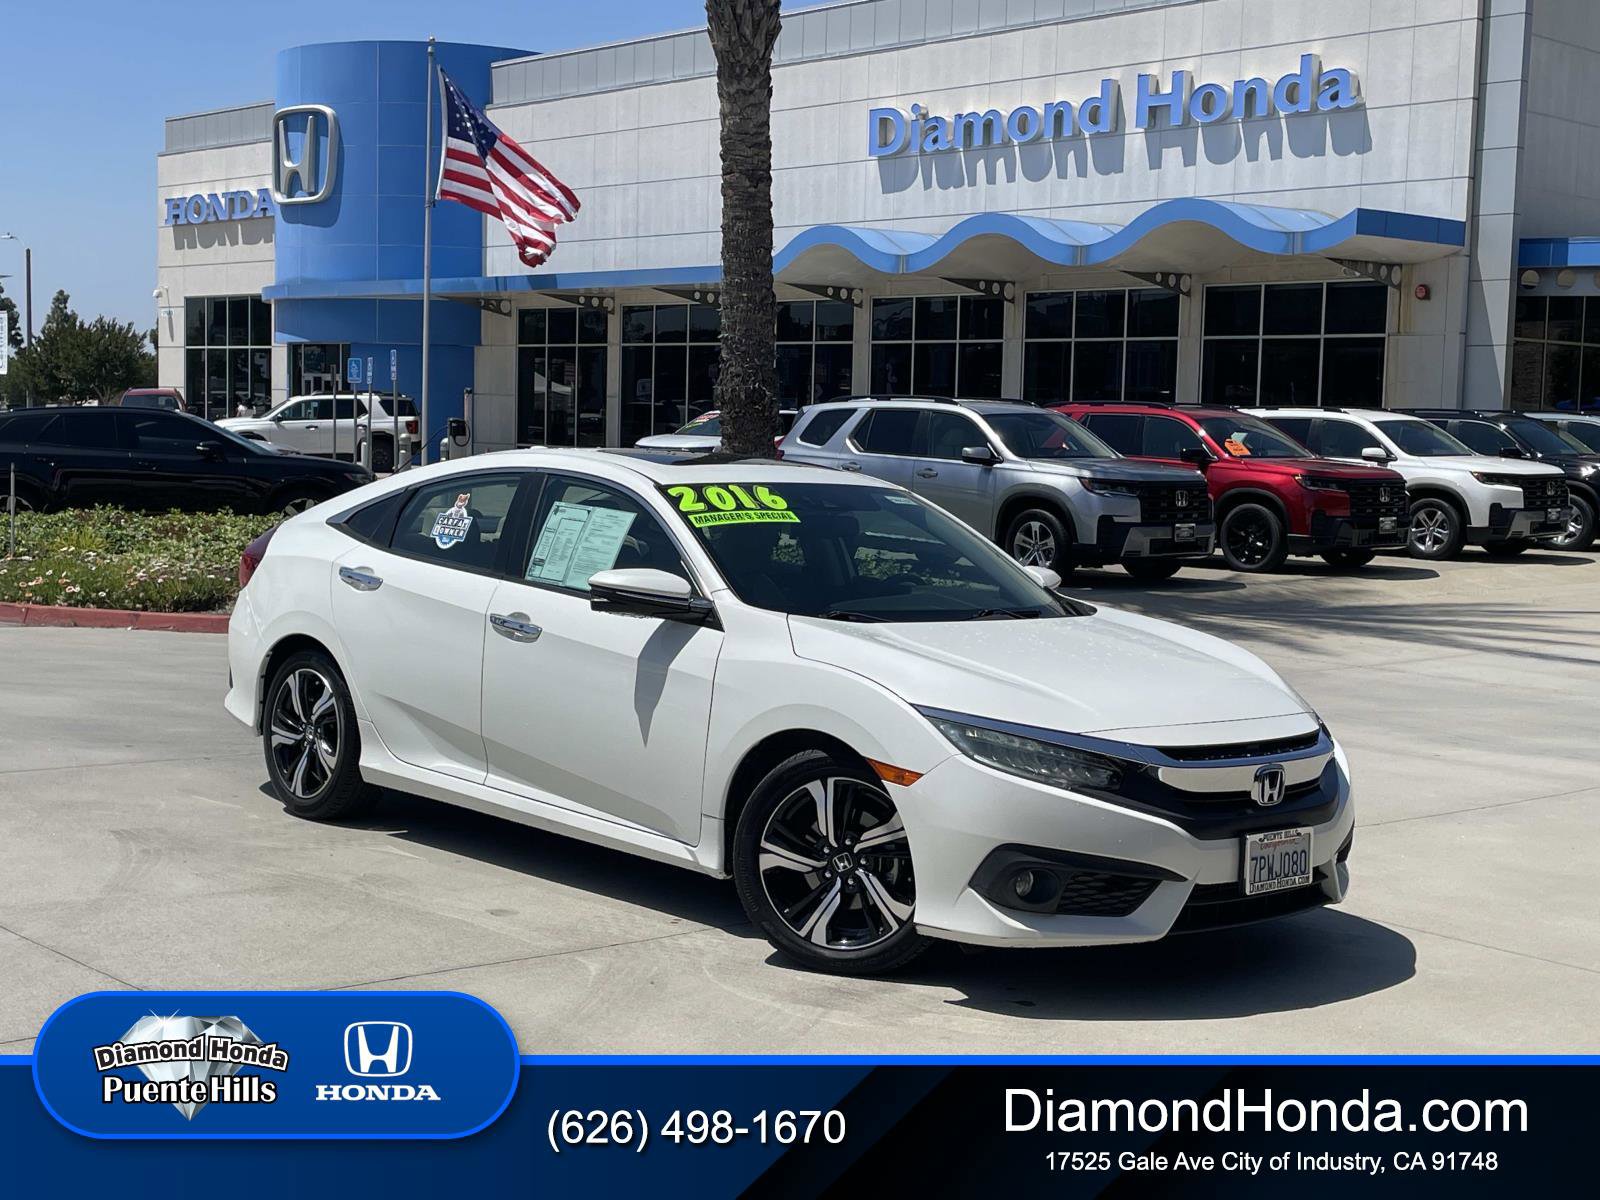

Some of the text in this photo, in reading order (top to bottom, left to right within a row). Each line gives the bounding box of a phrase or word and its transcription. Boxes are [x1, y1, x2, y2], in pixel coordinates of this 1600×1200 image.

[868, 53, 1360, 158] Diamond Honda
[164, 187, 275, 226] HONDA
[667, 484, 788, 512] 2016
[693, 510, 796, 525] MANAGER'S SPECIAL
[1250, 849, 1308, 884] 7PWJ080
